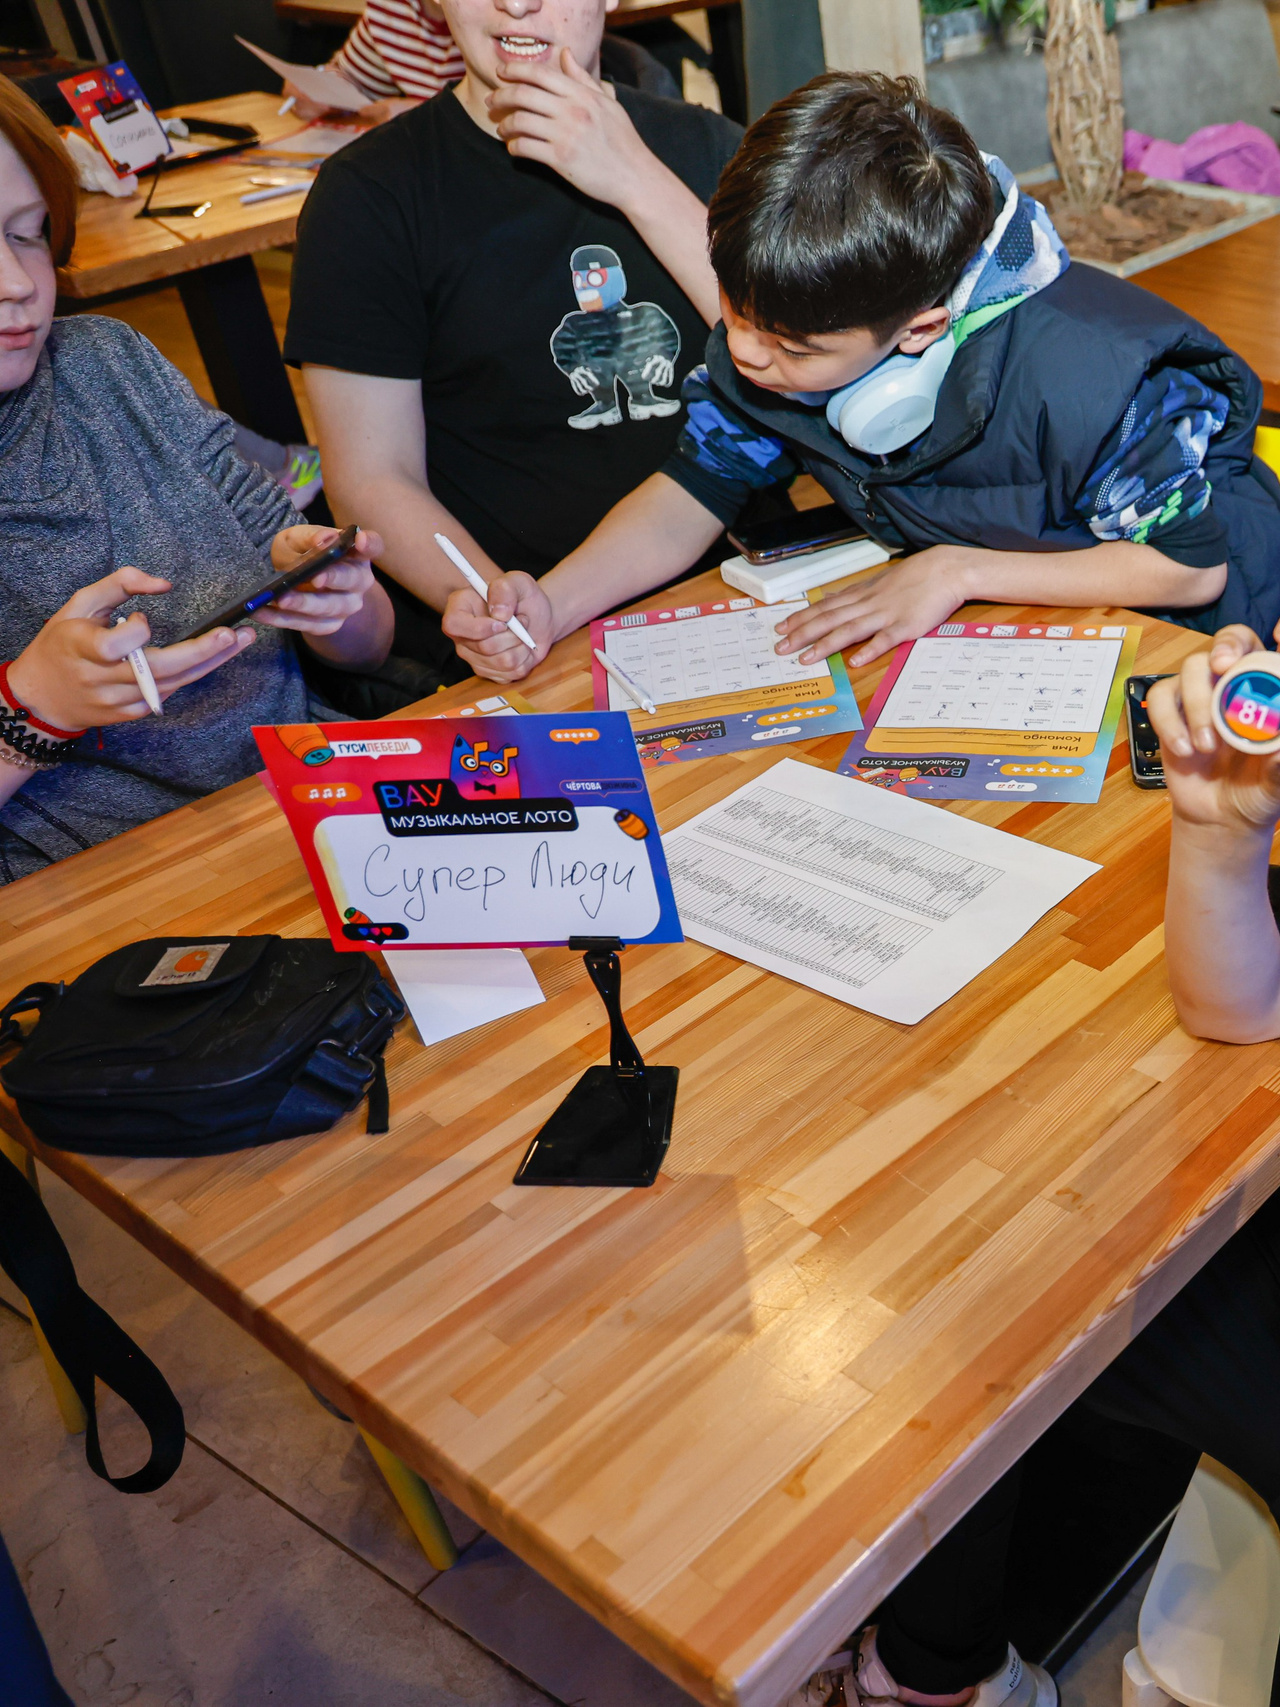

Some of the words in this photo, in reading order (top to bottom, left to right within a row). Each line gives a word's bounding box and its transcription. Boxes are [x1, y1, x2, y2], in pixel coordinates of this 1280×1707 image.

[762, 682, 819, 695] Команда
[794, 689, 821, 698] Имя
[1238, 699, 1270, 730] 81
[685, 729, 722, 742] ВАУ
[1023, 734, 1081, 743] Команда
[1052, 744, 1079, 752] Имя
[890, 759, 966, 767] МУЗЫКАЛЬНОЕ
[924, 767, 963, 777] ВАУ
[379, 783, 443, 809] ВАУ
[390, 811, 521, 828] МУЗЫКАЛЬНОЕ
[525, 810, 572, 824] ЛОТО
[364, 843, 506, 922] Супер
[531, 840, 636, 919] Люди
